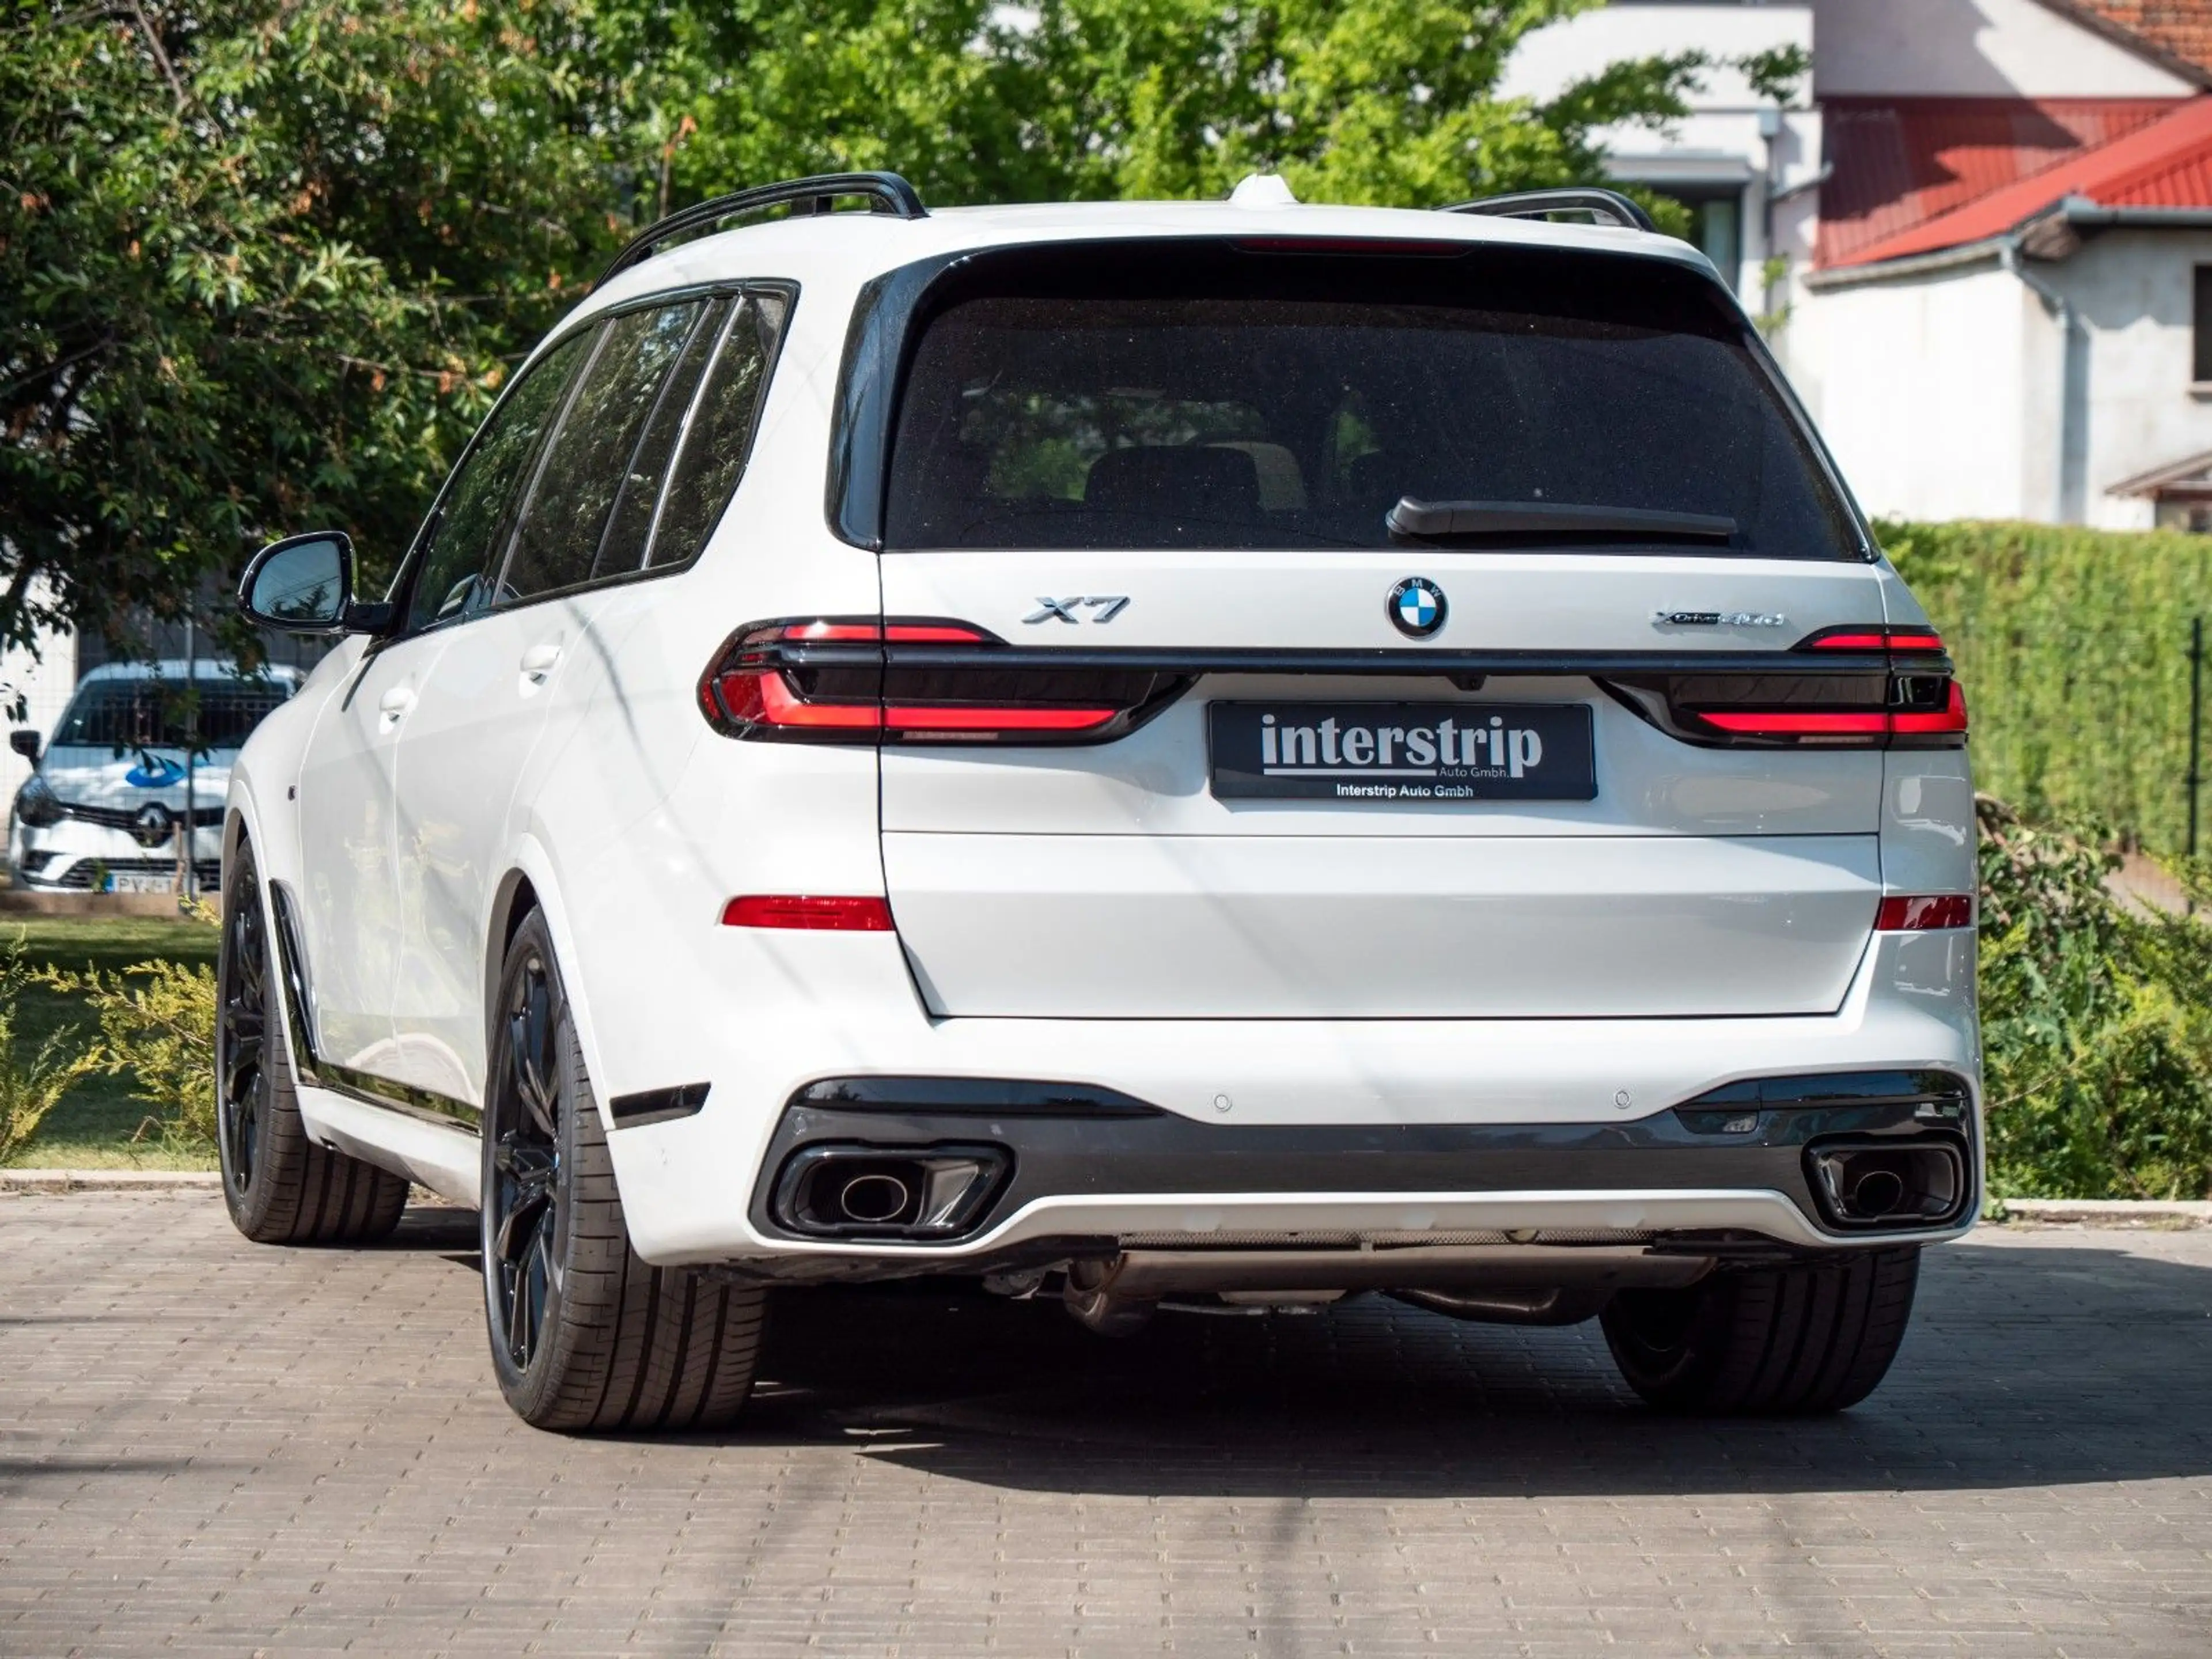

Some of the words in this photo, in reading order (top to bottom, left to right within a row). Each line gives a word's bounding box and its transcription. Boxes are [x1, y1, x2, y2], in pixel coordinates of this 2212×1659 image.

[1393, 578, 1441, 597] BMW
[1021, 596, 1130, 624] X7
[1262, 714, 1543, 778] interstrip
[1440, 768, 1467, 777] Auto
[1336, 784, 1396, 797] Interstrip
[1399, 785, 1430, 797] Auto
[1434, 785, 1474, 797] Gmbh
